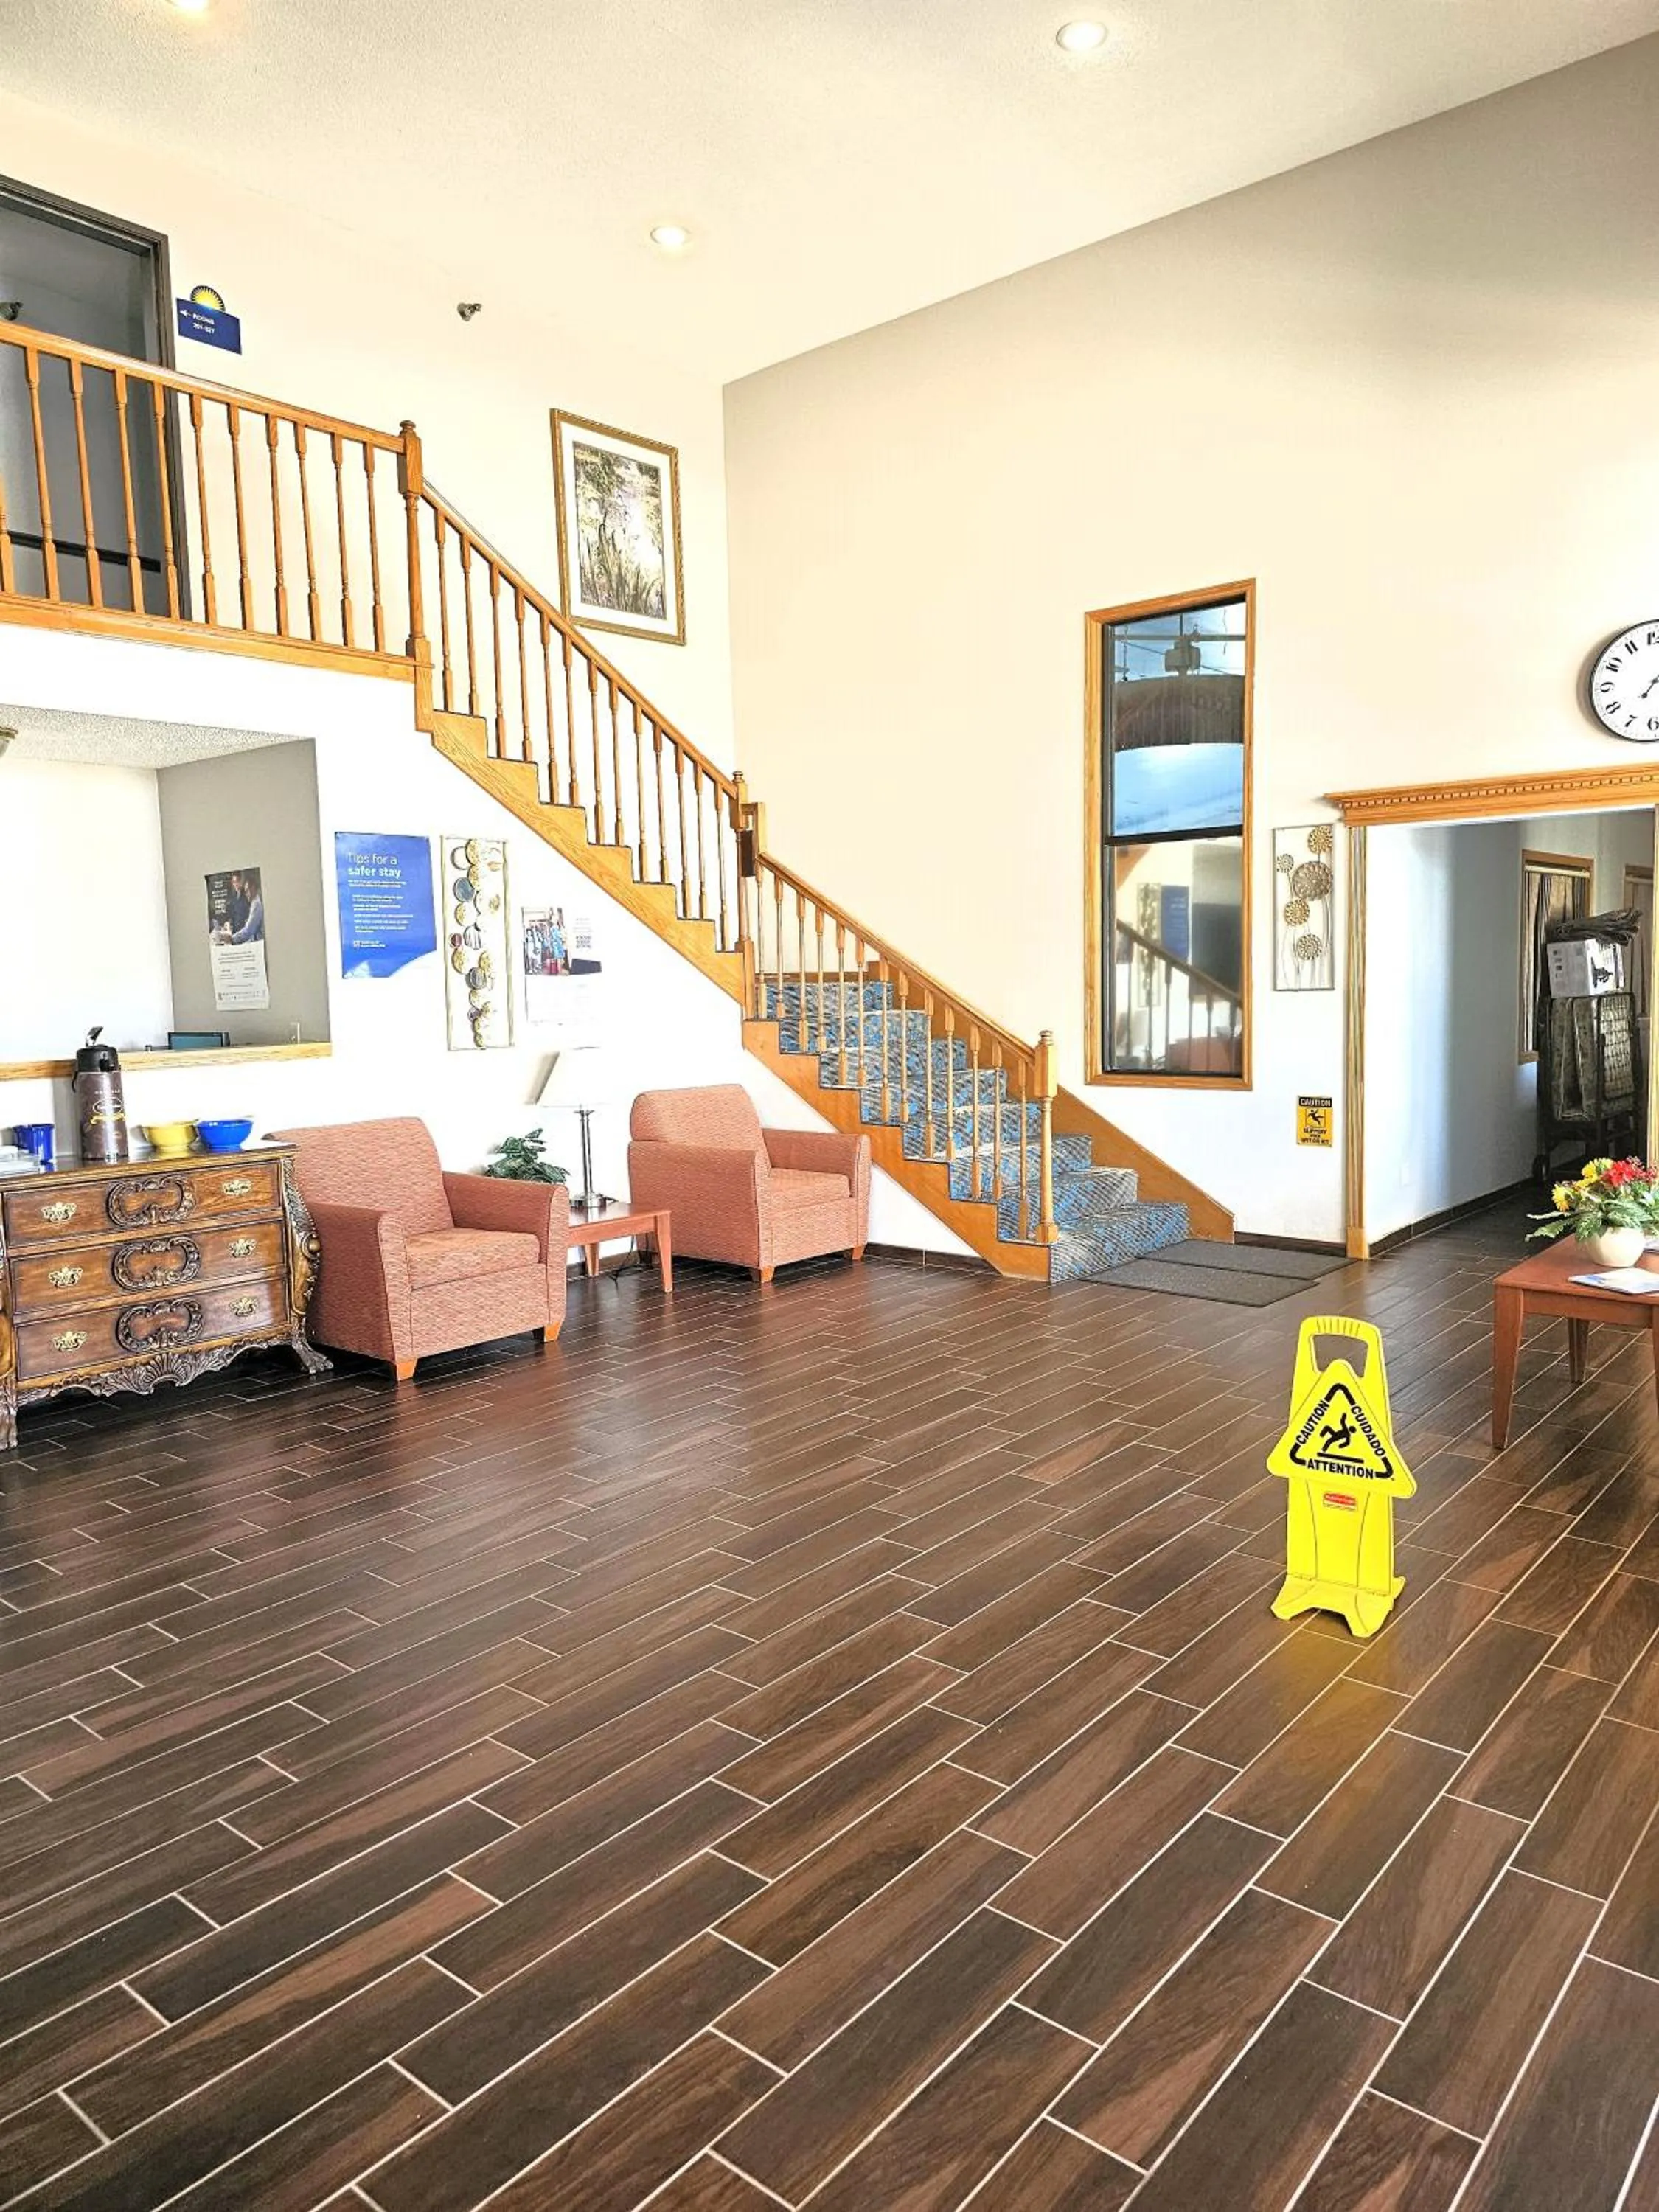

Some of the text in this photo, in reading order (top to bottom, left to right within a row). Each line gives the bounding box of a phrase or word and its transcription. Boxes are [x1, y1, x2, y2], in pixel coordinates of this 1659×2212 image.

[1624, 640, 1639, 655] 11
[1605, 657, 1623, 672] 10
[1599, 681, 1615, 693] 9
[1605, 701, 1621, 714] 8
[1624, 714, 1638, 728] 7
[1647, 716, 1659, 731] 6
[349, 852, 398, 865] Tips for a
[348, 866, 401, 879] safer stay
[1300, 1098, 1331, 1107] CAUTION
[1295, 1399, 1329, 1444] CAUTION
[1351, 1405, 1385, 1457] CUIDADO
[1307, 1458, 1374, 1478] ATTENTION
